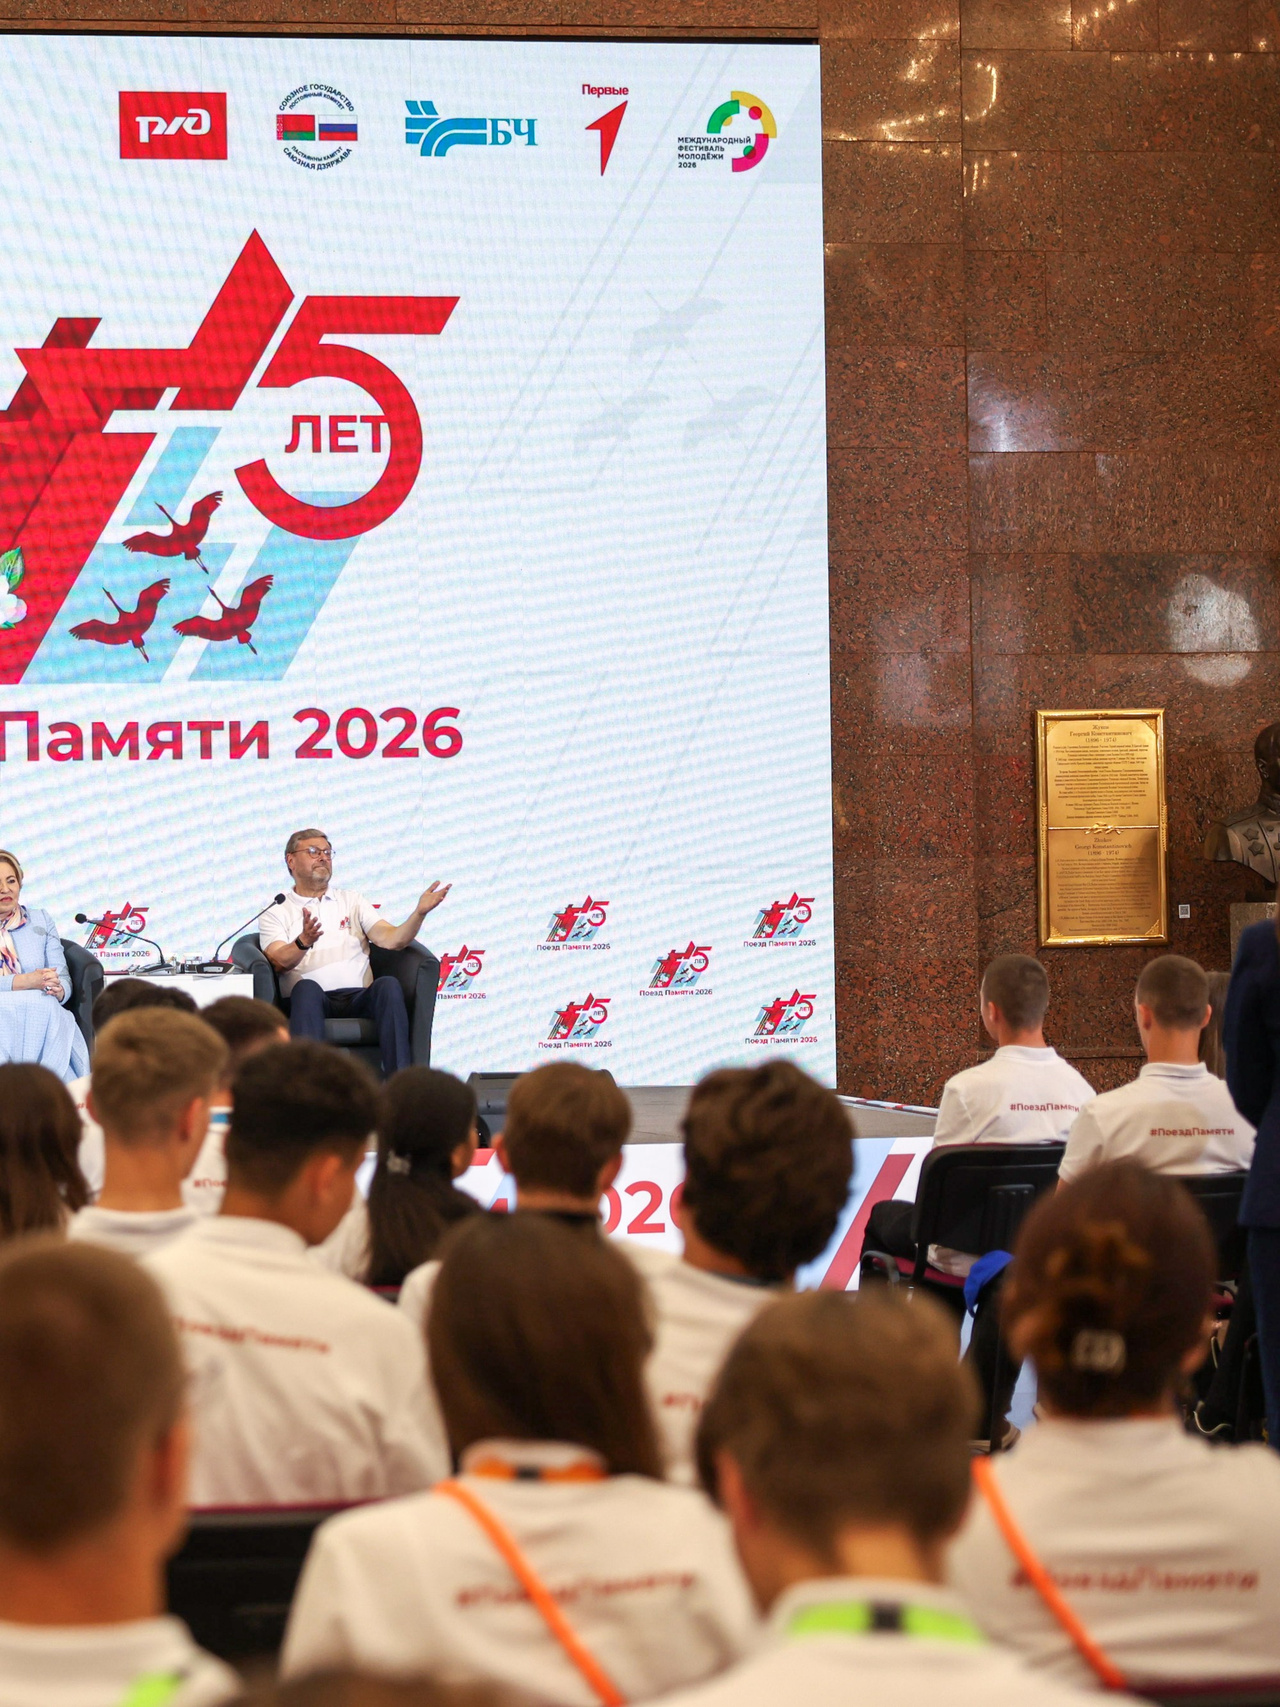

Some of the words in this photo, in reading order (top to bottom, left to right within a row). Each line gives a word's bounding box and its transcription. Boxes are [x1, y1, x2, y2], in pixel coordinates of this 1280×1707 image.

[279, 85, 309, 111] СОЮЗНОЕ
[309, 84, 354, 112] ГОСУДАРСТВО
[581, 83, 629, 97] Первые
[488, 118, 538, 146] БЧ
[678, 136, 751, 144] МЕЖДУНАРОДНЫЙ
[283, 147, 315, 169] САЮЗНАЯ
[317, 147, 352, 171] ДЗЯРЖАВА
[678, 153, 723, 161] МОЛОДЁЖИ
[234, 295, 461, 541] 5
[284, 415, 387, 453] ЛЕТ
[295, 707, 463, 760] 2026
[1009, 1103, 1080, 1112] #ПоездПамяти
[1150, 1127, 1234, 1138] #ПоездПамяти
